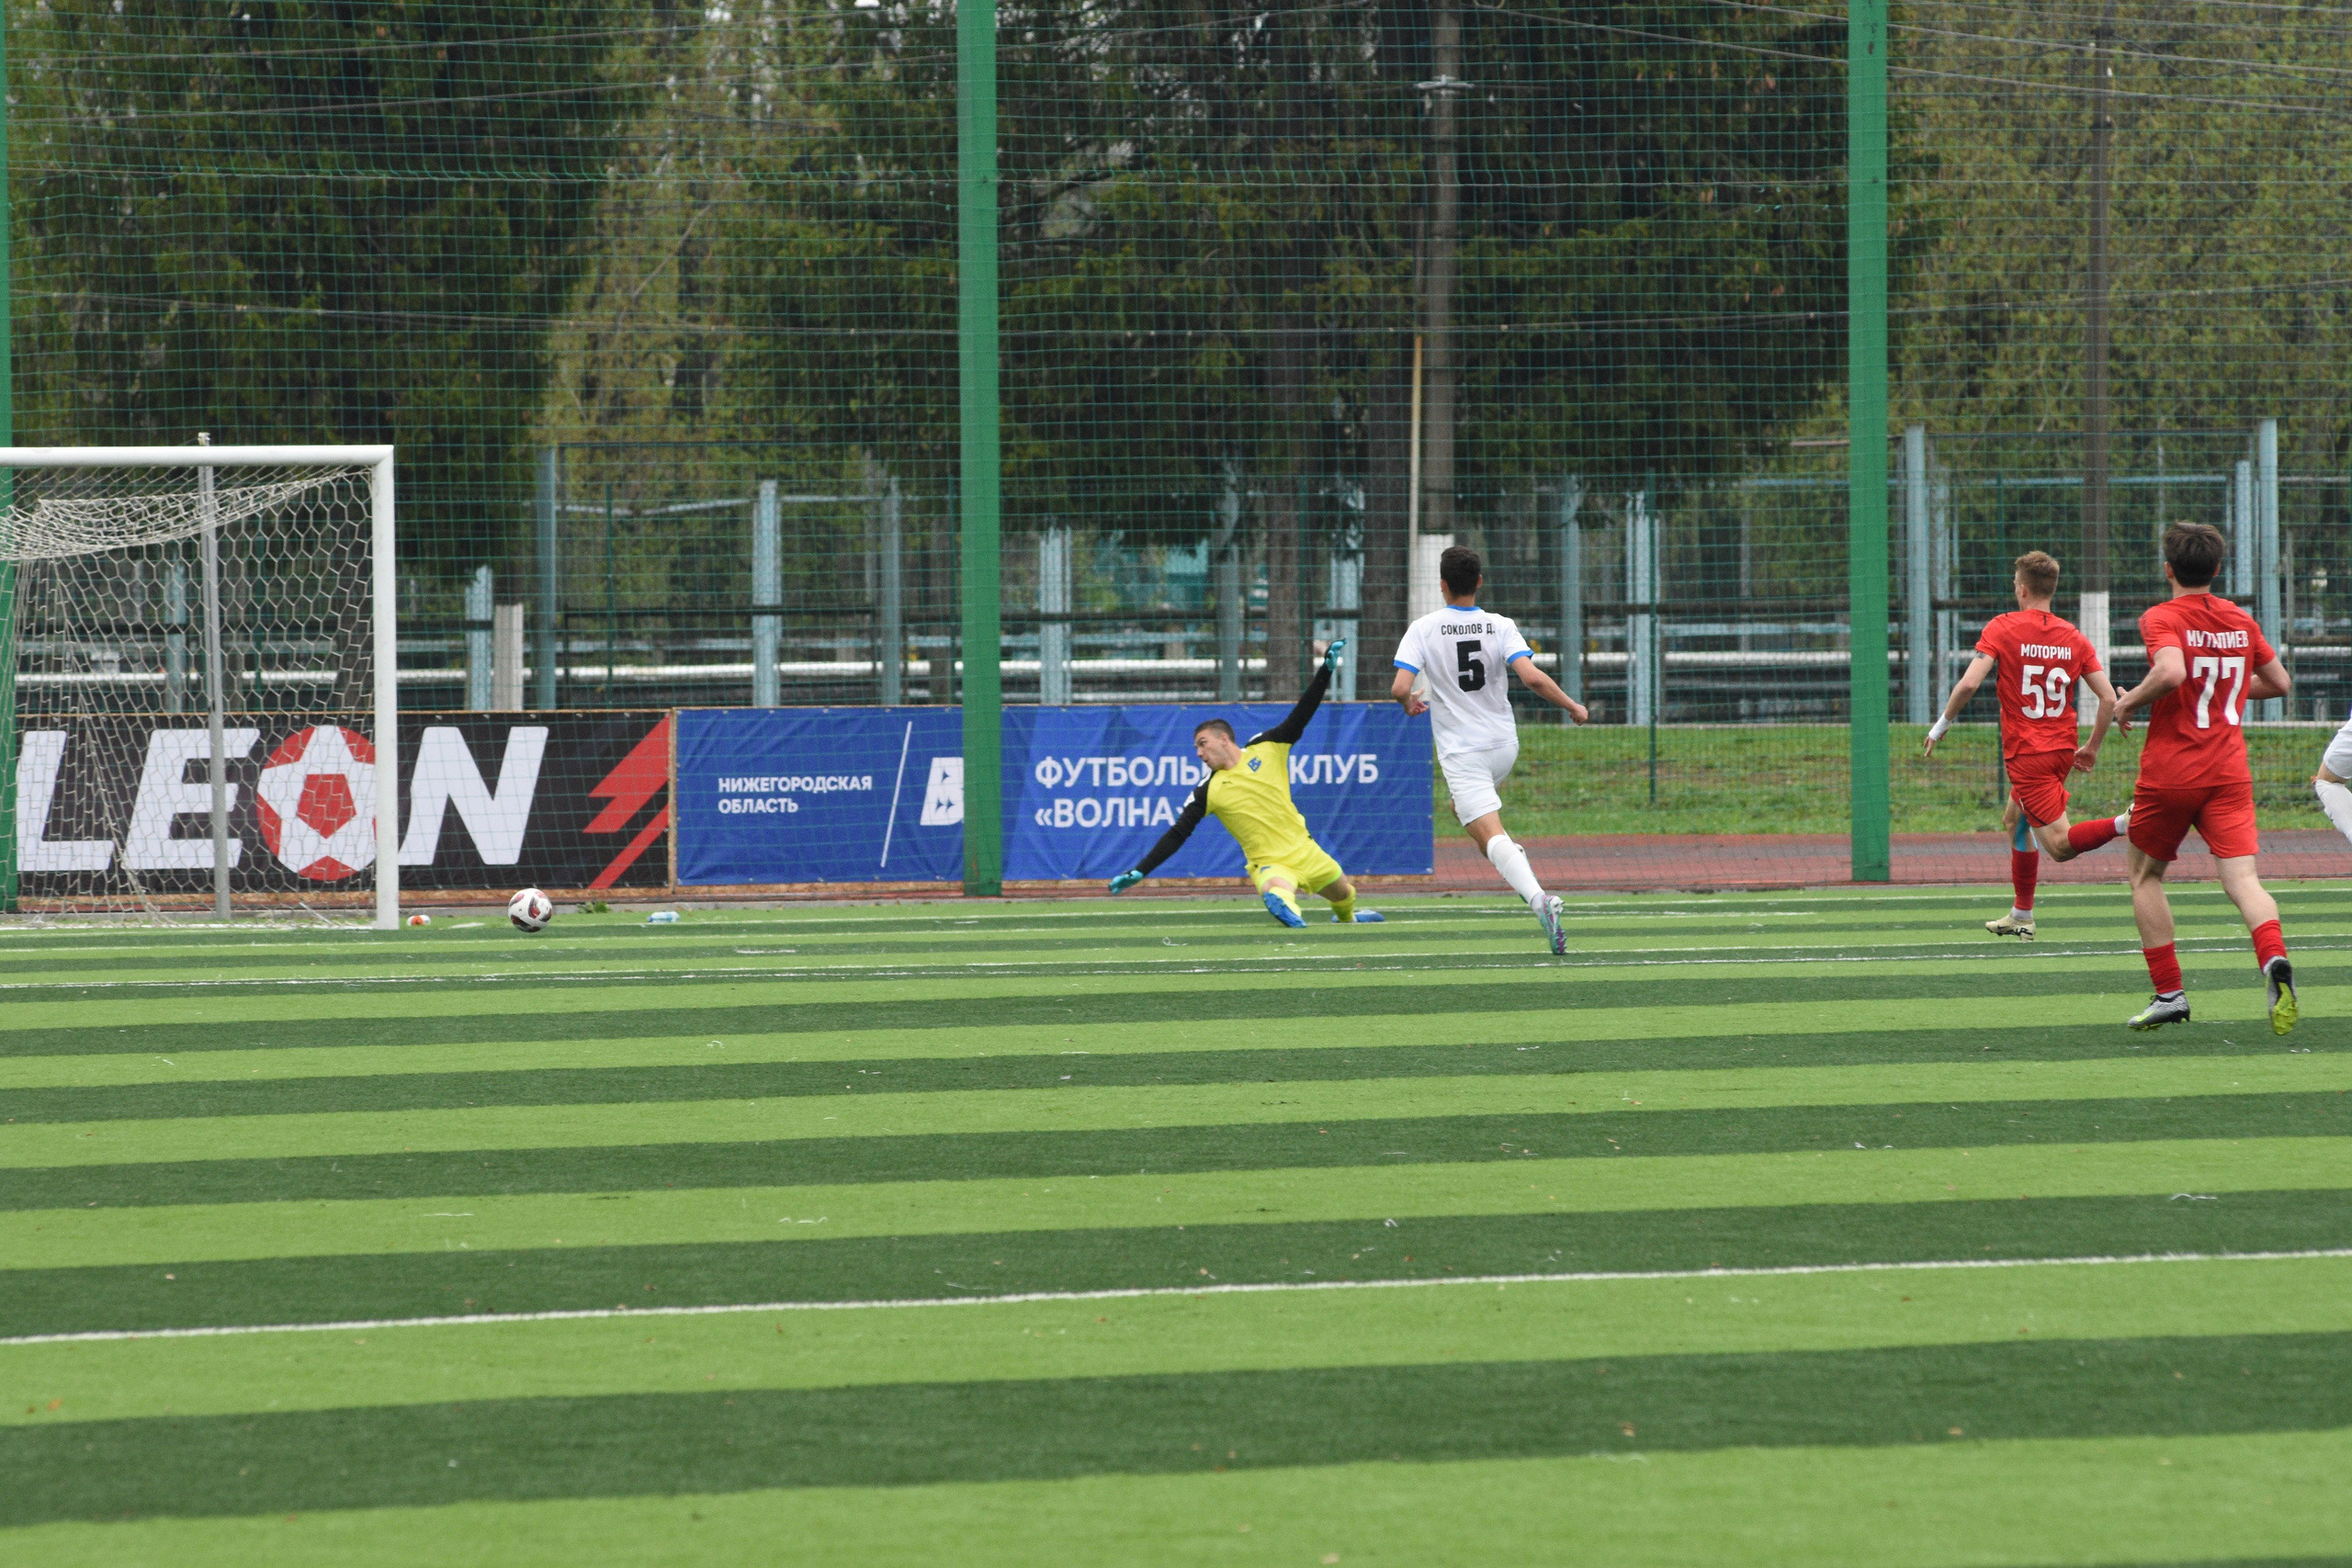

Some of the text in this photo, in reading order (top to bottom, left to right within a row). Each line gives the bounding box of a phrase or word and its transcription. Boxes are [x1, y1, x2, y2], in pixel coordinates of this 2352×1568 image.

[1441, 623, 1496, 636] СОКОЛОВ Д.
[2020, 643, 2072, 660] МОТОРИН
[1456, 639, 1486, 693] 5
[2021, 664, 2071, 719] 59
[2192, 656, 2245, 728] 77
[718, 775, 873, 794] НИЖЕГОРОДСКАЯ
[1035, 753, 1379, 789] ФУТБОЛЬ КЛУБ
[718, 797, 799, 814] ОБЛАСТЬ
